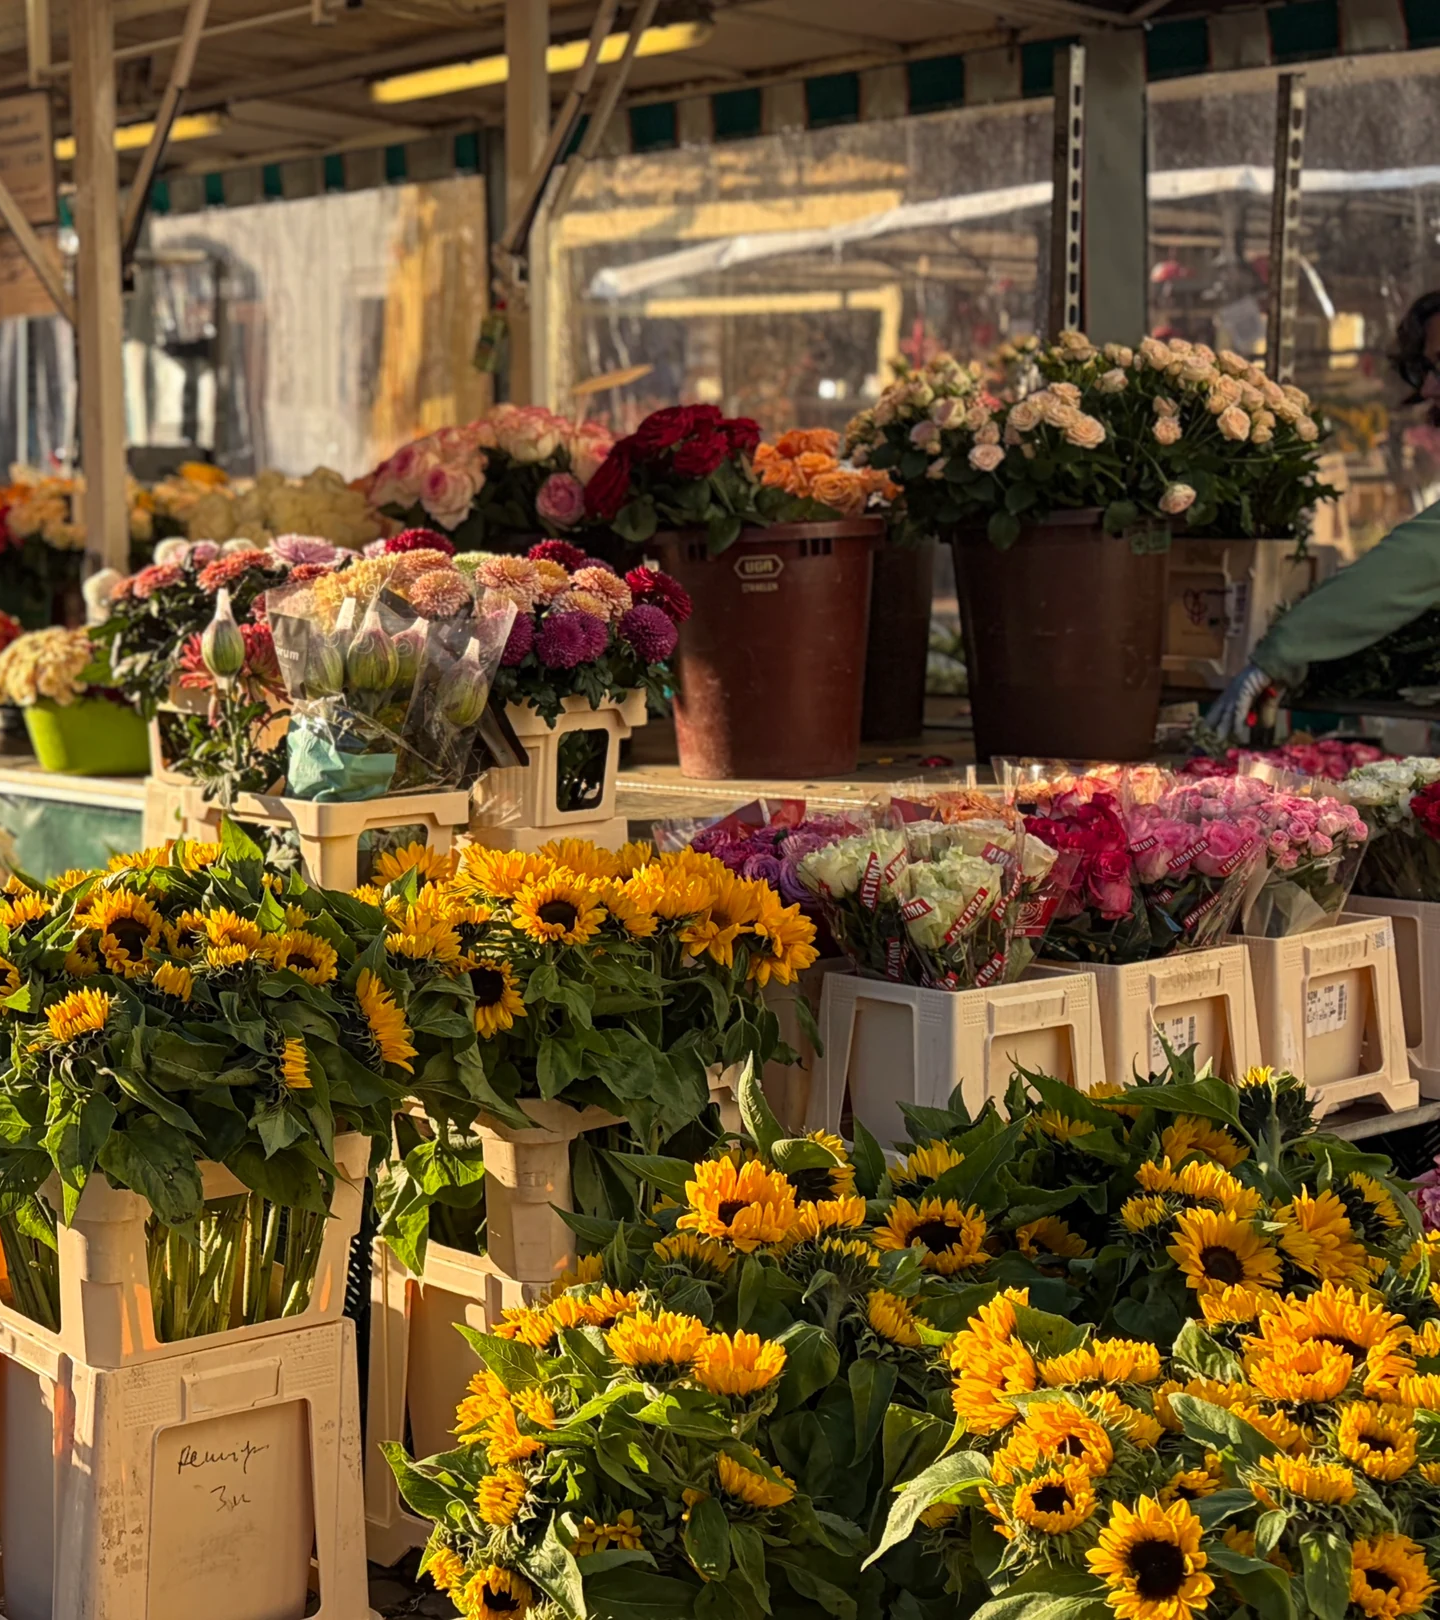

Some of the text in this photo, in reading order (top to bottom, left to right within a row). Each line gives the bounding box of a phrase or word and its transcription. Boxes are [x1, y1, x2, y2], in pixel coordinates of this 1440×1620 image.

[1169, 840, 1209, 869] TIMAFLOR
[1222, 839, 1253, 873] TIMAFLOR
[862, 858, 881, 909] ALTIMA
[949, 893, 985, 941] ALTIMA
